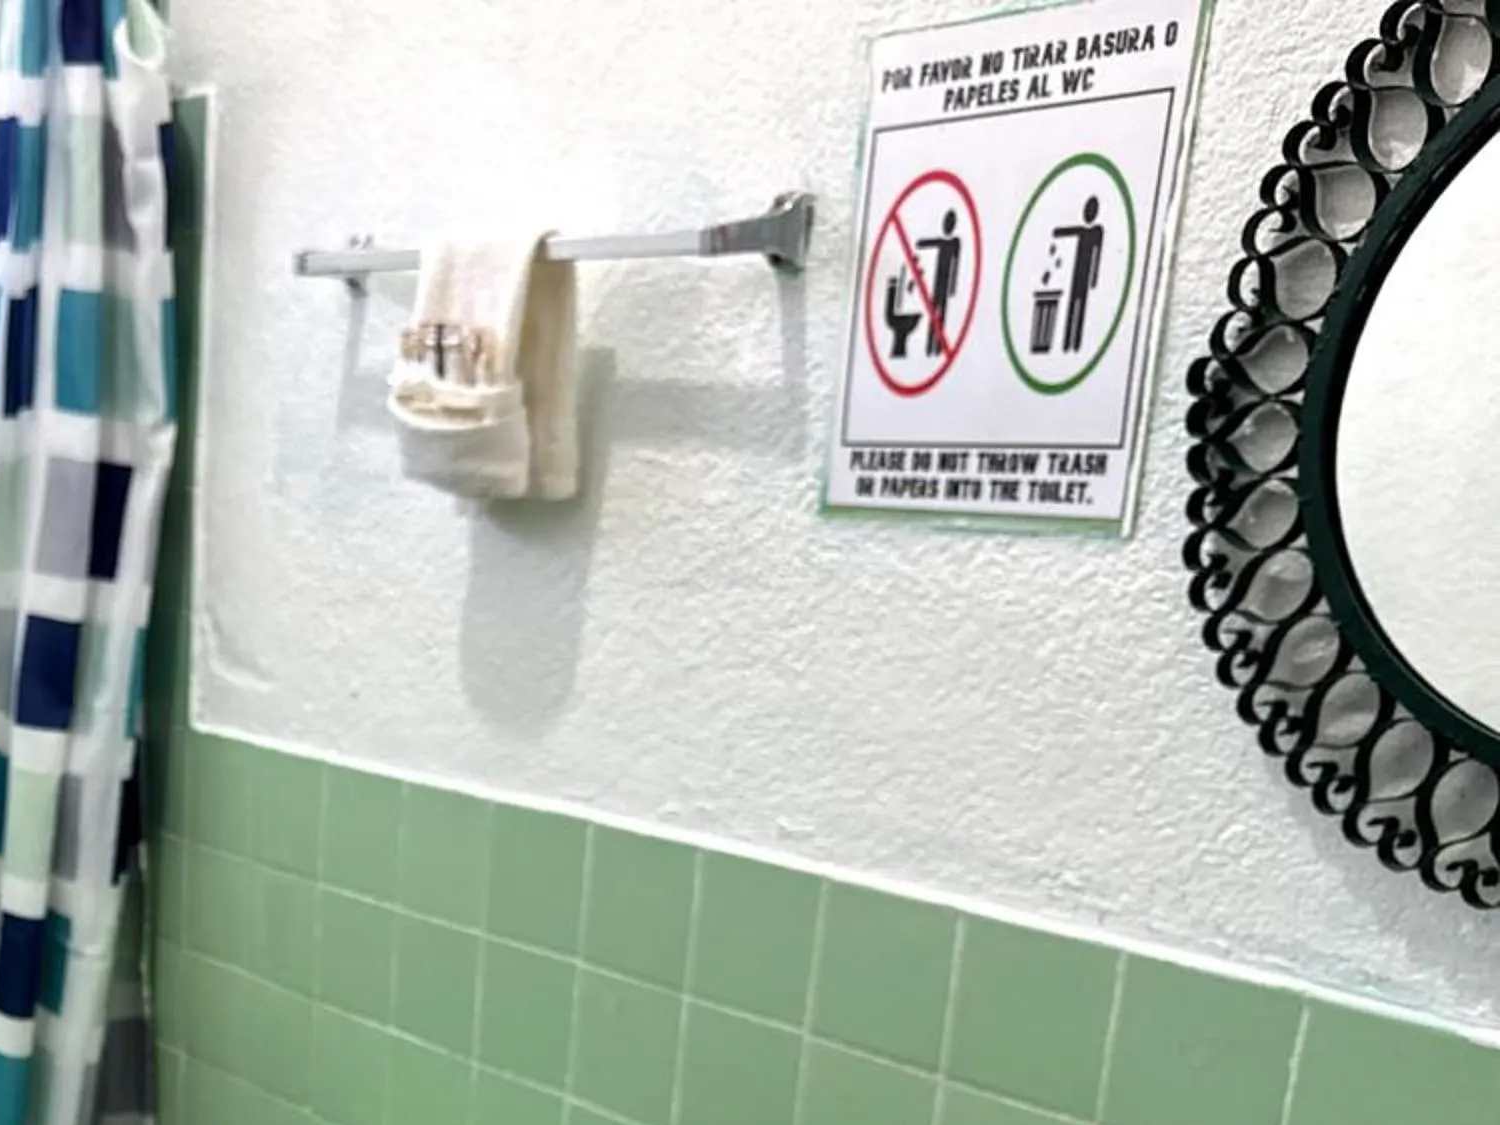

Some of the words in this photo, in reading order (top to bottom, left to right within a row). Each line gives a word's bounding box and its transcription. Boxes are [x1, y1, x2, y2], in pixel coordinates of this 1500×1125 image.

[882, 68, 912, 93] POR
[919, 56, 974, 87] FAVOR
[980, 50, 1004, 75] NO
[1012, 41, 1068, 72] TIRAR
[1075, 25, 1155, 61] BASURA
[1165, 21, 1179, 46] O
[943, 79, 1020, 112] PAPELES
[1027, 73, 1051, 100] AL
[1062, 68, 1095, 94] WC
[850, 450, 905, 471] PLEASE
[911, 451, 931, 471] DO
[937, 451, 969, 473] NOT
[977, 452, 1040, 474] THROW
[1048, 452, 1107, 476] TRASH
[879, 477, 938, 499] PAPERS
[945, 478, 982, 500] INTO
[990, 480, 1021, 502] THE
[1028, 480, 1093, 505] TOILET.
